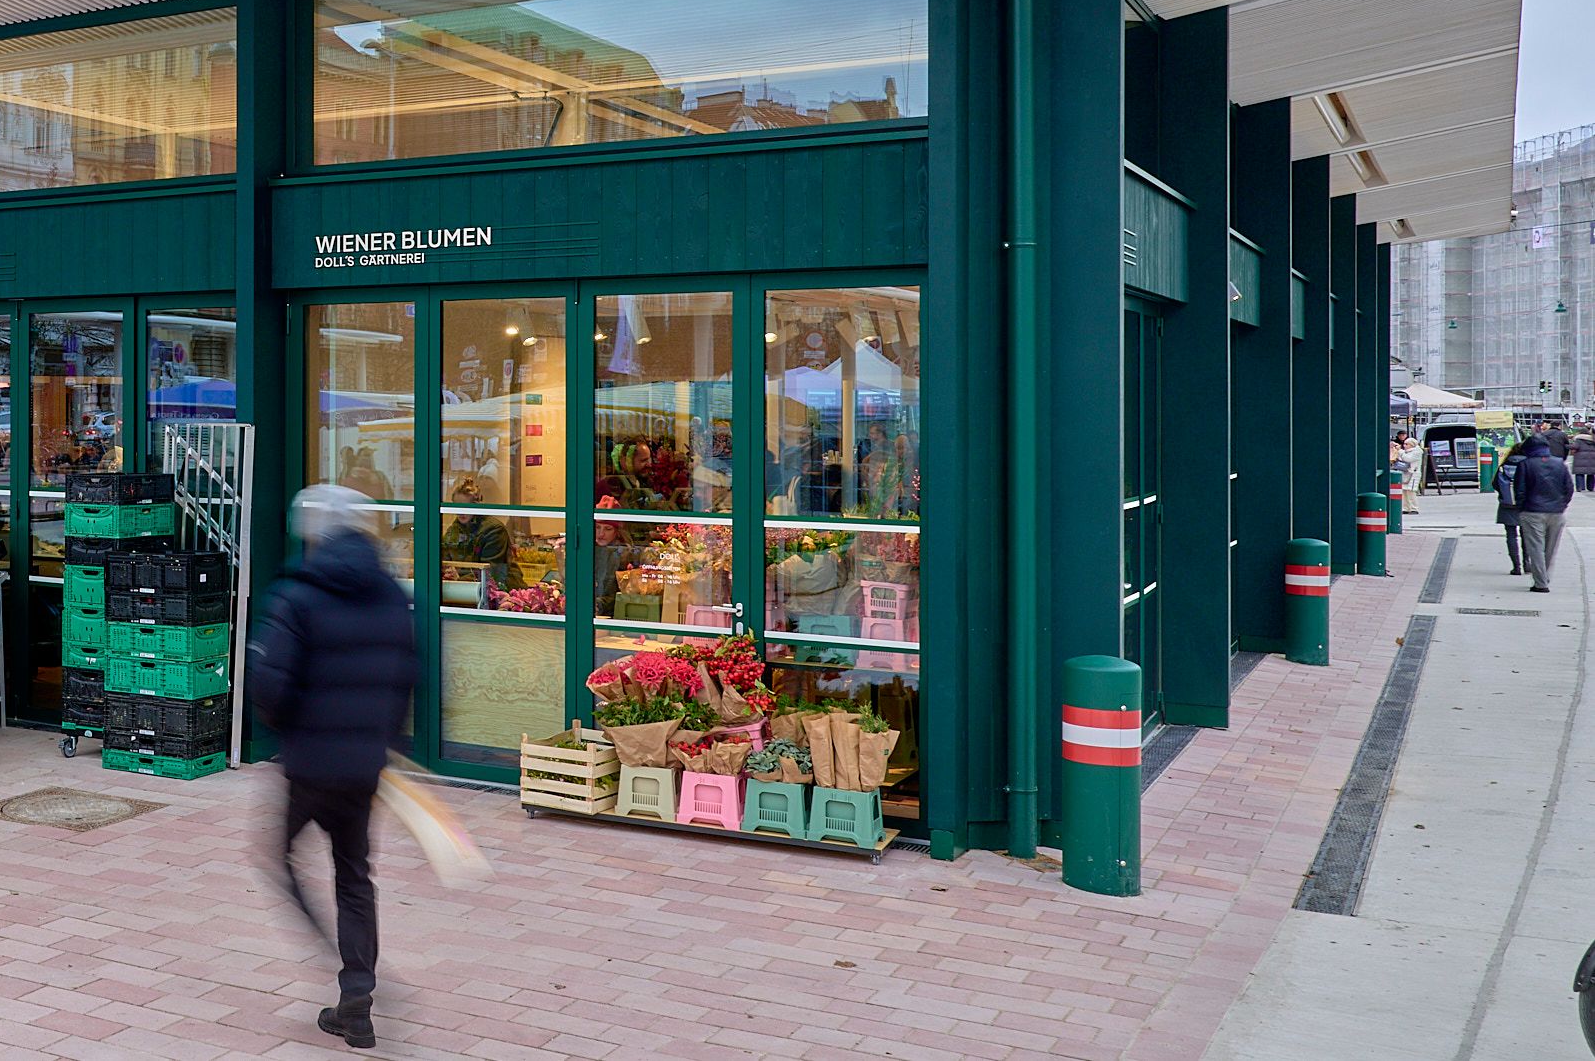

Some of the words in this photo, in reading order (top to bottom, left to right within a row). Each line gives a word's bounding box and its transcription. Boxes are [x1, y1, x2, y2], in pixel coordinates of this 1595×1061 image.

[315, 231, 396, 254] WIENER
[400, 226, 492, 250] BLUMEN
[359, 252, 425, 266] GÄRTNEREI
